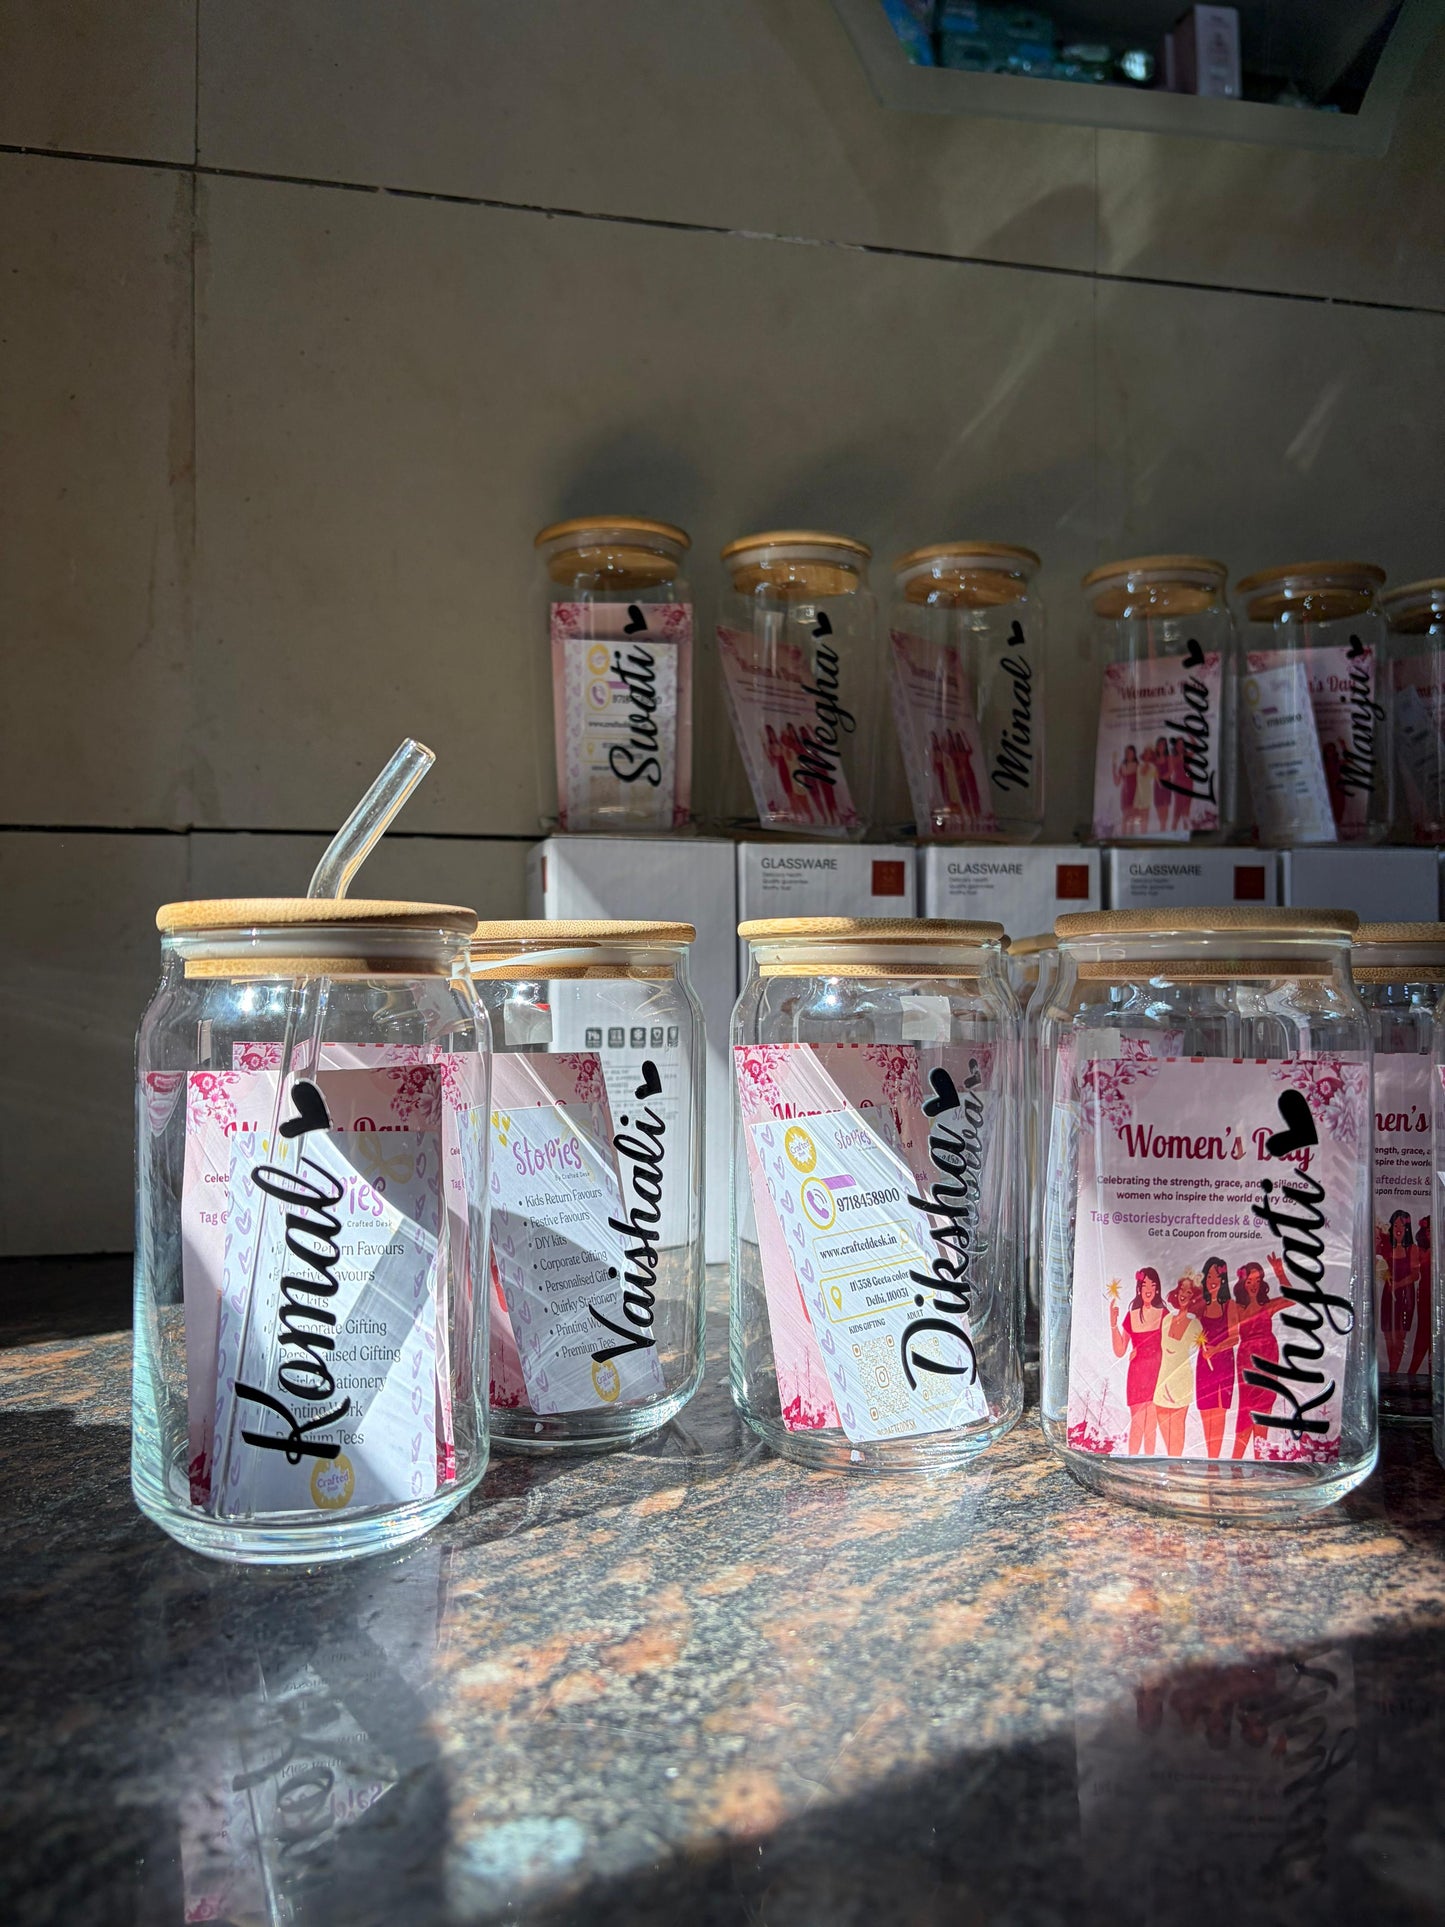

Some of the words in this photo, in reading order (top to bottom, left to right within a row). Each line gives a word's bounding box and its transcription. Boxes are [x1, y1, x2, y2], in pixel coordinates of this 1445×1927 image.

[609, 645, 661, 787] Swati
[792, 644, 856, 789] Megha
[991, 655, 1032, 791] Minal
[1337, 665, 1385, 797] Manju
[1160, 676, 1217, 804] Laiba
[761, 857, 838, 870] GLASSWARE
[948, 863, 1023, 875] GLASSWARE
[1129, 864, 1202, 876] GLASSWARE
[834, 1129, 872, 1150] Stories
[1118, 1124, 1246, 1160] Women's
[513, 1136, 582, 1176] Stories
[1401, 1148, 1425, 1156] grace,
[1097, 1175, 1150, 1187] Celebrating
[1153, 1177, 1168, 1186] the
[1170, 1178, 1213, 1188] strength,
[1214, 1180, 1243, 1189] grace,
[525, 1194, 544, 1207] Kids
[545, 1192, 572, 1205] Return
[572, 1188, 603, 1201] Favours
[836, 1187, 900, 1212] 9718458900
[1116, 1192, 1150, 1200] women
[1153, 1191, 1173, 1200] who
[1175, 1192, 1206, 1203] inspire
[1209, 1193, 1224, 1202] the
[1227, 1193, 1252, 1202] world
[1394, 1187, 1412, 1196] from
[200, 1212, 218, 1226] Tag
[347, 1220, 374, 1228] Crafted
[530, 1214, 558, 1228] Festive
[559, 1211, 591, 1224] Favours
[1090, 1211, 1109, 1225] Tag
[1112, 1211, 1240, 1226] @storiesbycrafteddesk
[1243, 1215, 1250, 1226] &
[535, 1236, 552, 1249] DIY
[552, 1234, 567, 1246] kits
[589, 1107, 666, 1363] Vaishali
[1148, 1228, 1164, 1237] Get
[1165, 1229, 1170, 1237] a
[1172, 1228, 1205, 1239] Coupon
[1207, 1229, 1227, 1238] from
[1229, 1230, 1263, 1239] ourside.
[357, 1241, 404, 1256] Favours
[820, 1233, 898, 1259] www.crafteddesk.in
[540, 1256, 581, 1271] Corporate
[581, 1250, 607, 1261] Gifting
[901, 1124, 977, 1391] Diksha
[333, 1268, 375, 1282] avours
[545, 1274, 595, 1292] Personalised
[872, 1274, 892, 1287] Geeta
[551, 1298, 578, 1316] Quirky
[578, 1292, 618, 1309] Stationery
[866, 1292, 887, 1307] Delhi,
[886, 1287, 909, 1302] 110031
[1243, 1168, 1355, 1440] Khyati
[235, 1156, 351, 1465] Komal
[907, 1309, 924, 1320] ADULT
[345, 1319, 387, 1336] Gifting
[556, 1321, 588, 1337] Printing
[849, 1322, 864, 1334] KIDS
[863, 1318, 886, 1331] GIFTING
[360, 1345, 401, 1363] Gifting
[561, 1343, 597, 1358] Premium
[597, 1337, 616, 1350] Tees
[334, 1374, 387, 1392] ationery
[337, 1430, 364, 1445] Tees
[317, 1472, 349, 1488] Crafted
